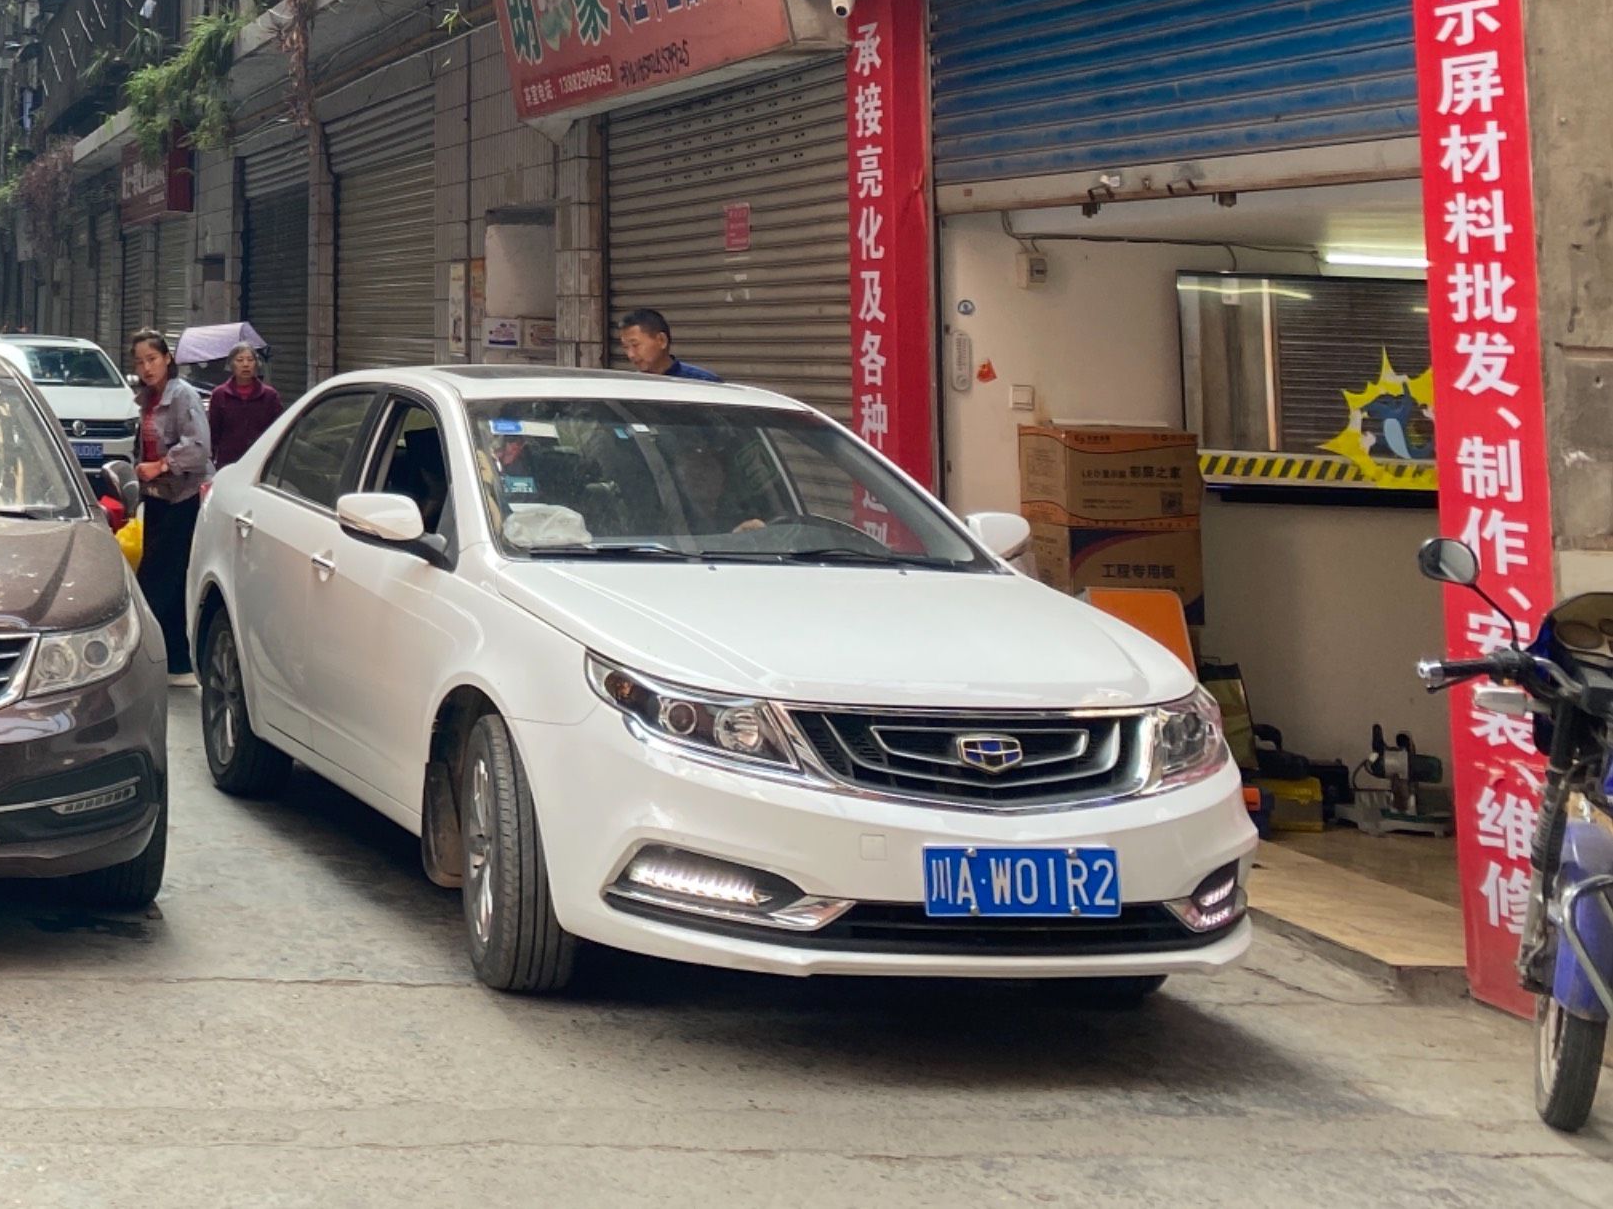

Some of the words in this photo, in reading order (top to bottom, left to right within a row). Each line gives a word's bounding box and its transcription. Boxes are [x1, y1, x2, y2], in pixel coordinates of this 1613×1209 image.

[1102, 564, 1177, 580] 工程专用板
